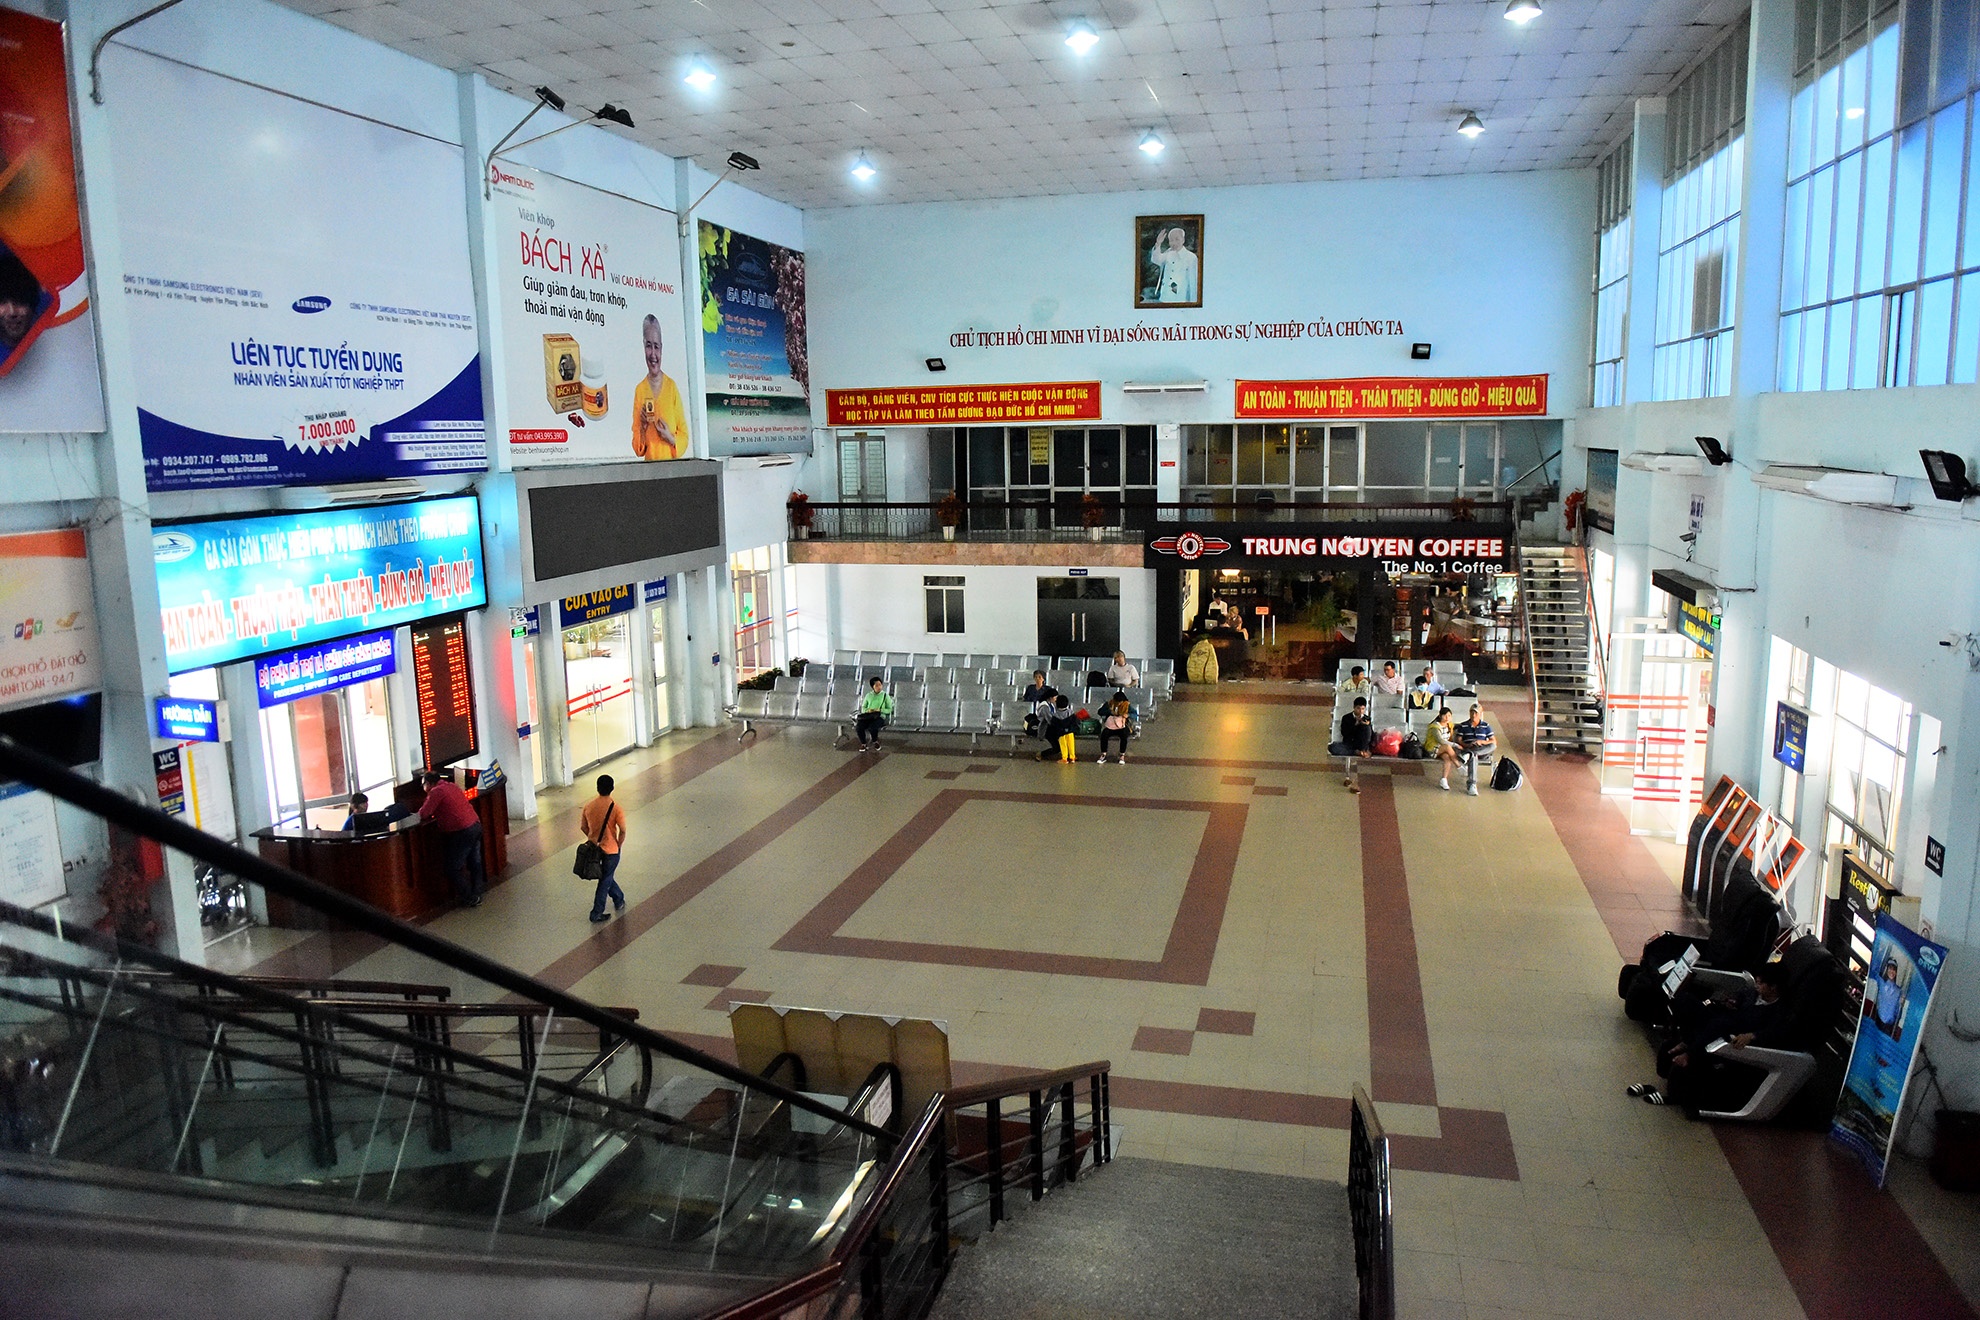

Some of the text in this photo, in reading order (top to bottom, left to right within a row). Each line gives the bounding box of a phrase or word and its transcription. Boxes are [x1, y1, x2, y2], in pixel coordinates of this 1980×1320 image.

[518, 207, 535, 222] Viên
[520, 228, 572, 274] BÁCH
[163, 279, 190, 290] SAMSUNG
[523, 275, 545, 296] Giúp
[546, 280, 568, 297] giảm
[570, 284, 588, 303] đau,
[621, 274, 634, 287] CAO
[657, 282, 675, 295] MANG
[726, 286, 740, 303] GA
[296, 300, 328, 310] SAMSUNG
[524, 299, 605, 327] thoải mái vận động
[949, 326, 975, 347] CHỦ
[977, 331, 1004, 349] TỊCH
[1007, 324, 1024, 346] HỒ
[1050, 329, 1085, 345] MINH
[1086, 325, 1101, 343] VĨ
[1103, 327, 1125, 346] ĐẠI
[1127, 320, 1160, 343] SỐNG
[1162, 323, 1187, 341] MÃI
[1189, 324, 1233, 341] TRONG
[1235, 320, 1253, 342] SỰ
[1255, 319, 1305, 341] NGHIỆP
[1307, 316, 1334, 338] CỦA
[1335, 317, 1384, 337] CHÚNG
[1386, 320, 1404, 336] TA
[230, 337, 403, 378] LIÊN TỤC TUYỂN DỤNG
[334, 372, 351, 390] TỐT
[384, 378, 404, 391] THPT
[921, 393, 936, 404] CNV
[938, 390, 957, 403] TÍCH
[999, 389, 1019, 404] HIỆN
[1045, 387, 1063, 402] VẬN
[1243, 378, 1537, 414] AN TOÀN THUẬN TIỆN THÂN THIỆN ĐÚNG GIỜ HIỆU QUẢ
[846, 411, 862, 423] HỌC
[864, 408, 879, 422] TẬP
[881, 408, 892, 420] VÀ
[894, 407, 913, 420] LÀM
[914, 408, 935, 419] THEO
[937, 405, 956, 419] TẤM
[986, 406, 1003, 419] ĐẠO
[1006, 404, 1022, 417] ĐỨC
[1038, 403, 1051, 416] CHÍ
[1053, 404, 1075, 415] MINH
[298, 418, 356, 441] 7.000.000
[204, 540, 221, 571] GA
[238, 527, 262, 567] GÒN
[260, 527, 288, 570] THỰC
[347, 515, 376, 551] KHÁCH
[376, 513, 399, 547] HÀNG
[398, 516, 419, 544] THEO
[1242, 538, 1317, 556] TRUNG
[1419, 538, 1503, 557] COFFEE
[1381, 560, 1503, 574] The No.1 Coffee
[614, 584, 629, 599] GA
[188, 590, 226, 650] TOÀN
[309, 573, 344, 625] THÂN
[341, 568, 376, 627] THIỆN
[378, 562, 409, 611] ĐÚNG
[408, 557, 426, 606] GIỜ
[429, 555, 453, 609] HIỆU
[586, 605, 611, 619] ENTRY
[14, 617, 43, 640] FPT
[159, 751, 176, 765] WC
[1930, 841, 1942, 860] WC
[1849, 869, 1868, 896] Rest
